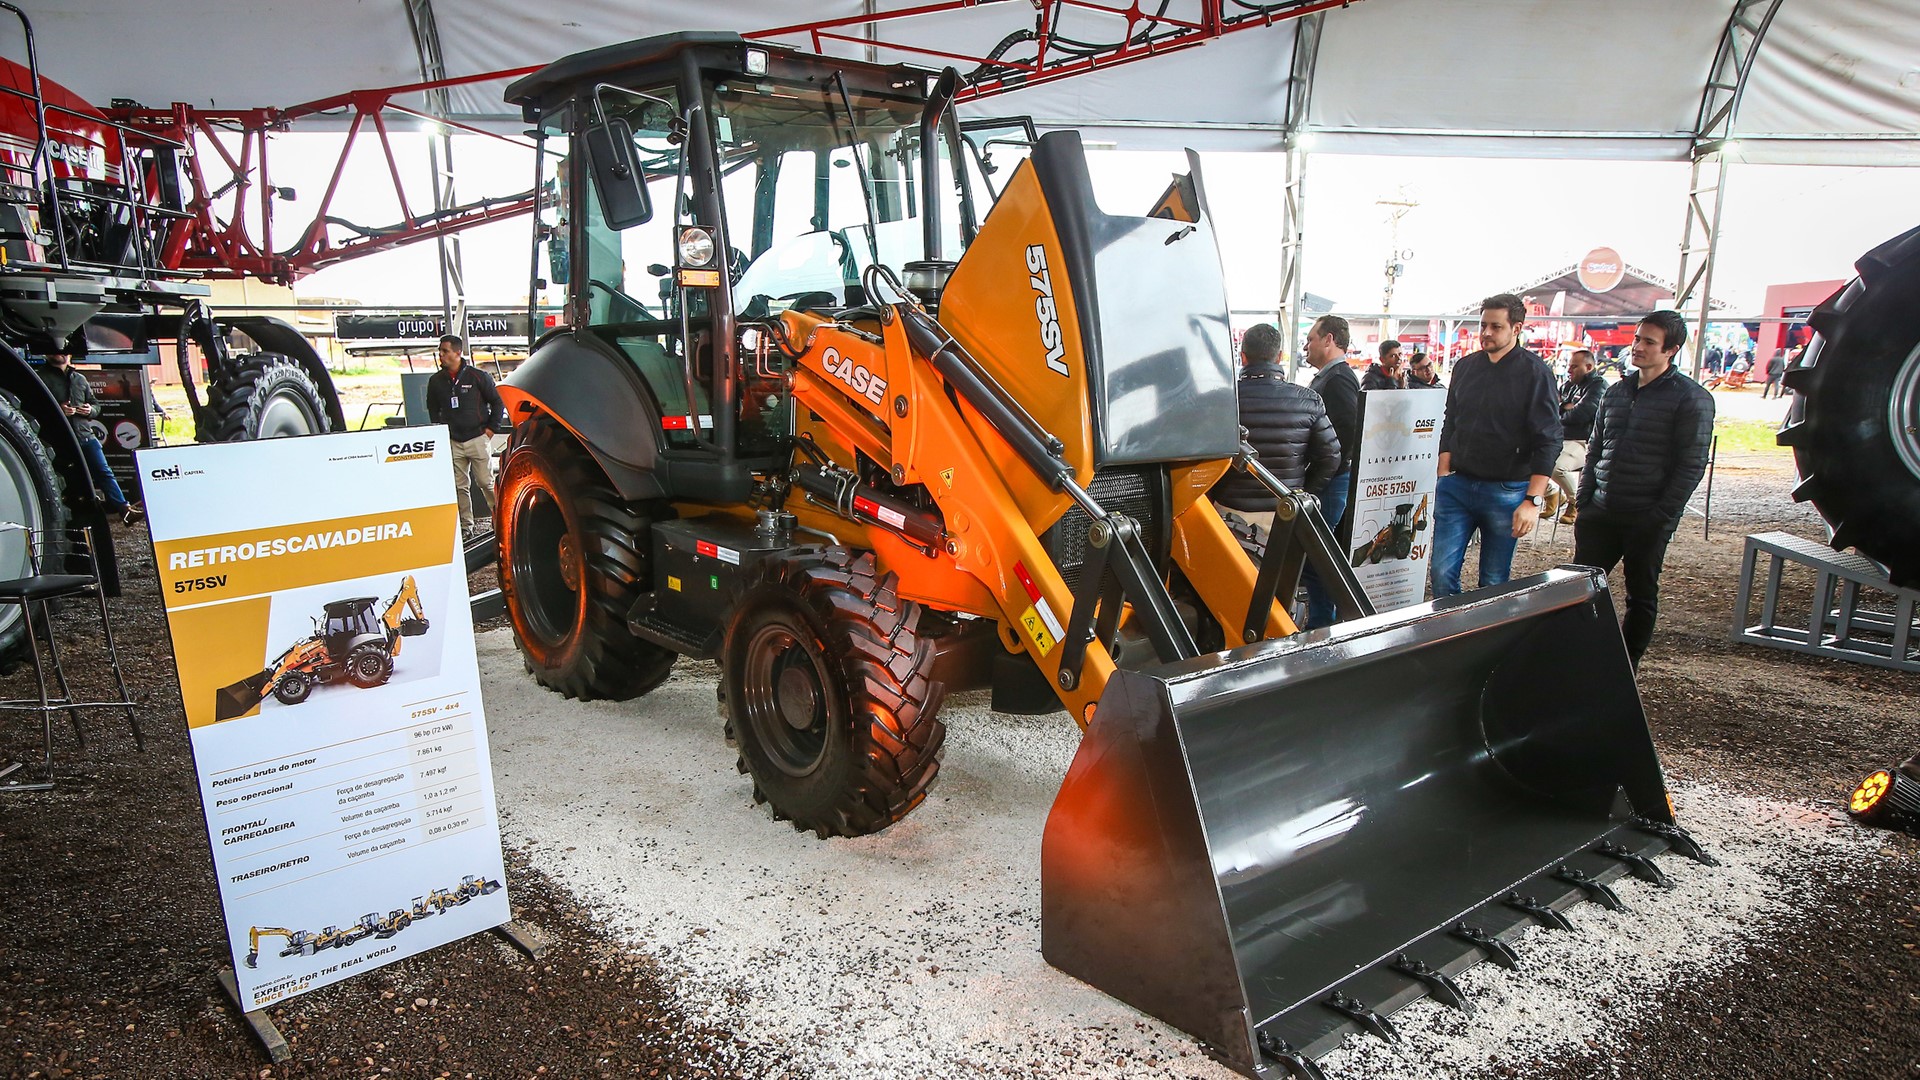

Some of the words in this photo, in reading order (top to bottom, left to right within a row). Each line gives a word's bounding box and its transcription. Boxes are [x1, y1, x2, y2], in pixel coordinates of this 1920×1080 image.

[49, 140, 88, 166] CASE
[1025, 244, 1070, 378] 575SV
[398, 319, 434, 335] grupo
[440, 319, 507, 331] FRARIN
[822, 346, 888, 406] CASE
[1415, 418, 1436, 428] CASE
[387, 440, 436, 455] CASE
[1368, 453, 1432, 464] LANÇAMENTO
[1366, 483, 1388, 498] CASE
[1389, 480, 1417, 495] 575SV
[169, 521, 414, 571] RETROESCAVADEIRA
[1410, 544, 1427, 561] SV
[174, 574, 228, 594] 575SV
[411, 706, 438, 719] 575SV
[444, 702, 460, 711] 4x4
[413, 730, 422, 738] 96
[431, 726, 442, 735] (72
[441, 724, 454, 733] kW)
[434, 745, 442, 754] kg
[212, 774, 251, 788] Potência
[253, 767, 277, 778] bruta
[278, 764, 290, 772] do
[291, 758, 317, 769] motor
[420, 769, 437, 778] 7.497
[437, 766, 447, 775] kgf
[336, 786, 354, 796] Força
[354, 782, 363, 791] de
[363, 773, 405, 789] desagregação
[439, 788, 449, 796] 1,2
[216, 797, 239, 808] Peso
[241, 782, 293, 801] operacional
[338, 797, 347, 805] da
[347, 790, 375, 803] caçamba
[340, 812, 364, 823] Volume
[364, 809, 373, 817] da
[373, 801, 400, 815] caçamba
[425, 808, 443, 818] 5.714
[443, 805, 453, 814] kgf
[221, 818, 268, 836] FRONTAL/
[223, 821, 296, 846] CARREGADEIRA
[344, 831, 361, 841] Força
[362, 828, 370, 836] de
[371, 817, 412, 834] desagregação
[428, 827, 442, 835] 0,08
[447, 822, 460, 831] 0,30
[347, 848, 370, 859] Volume
[370, 844, 379, 852] da
[379, 837, 406, 851] caçamba
[230, 855, 311, 883] TRASEIRO/RETRO
[254, 979, 297, 999] EXPERTS
[299, 972, 318, 983] FOR
[320, 965, 338, 977] THE
[341, 957, 364, 970] REAL
[366, 945, 397, 960] WORLD
[255, 991, 284, 1005] SINCE
[287, 982, 310, 994] 1842
